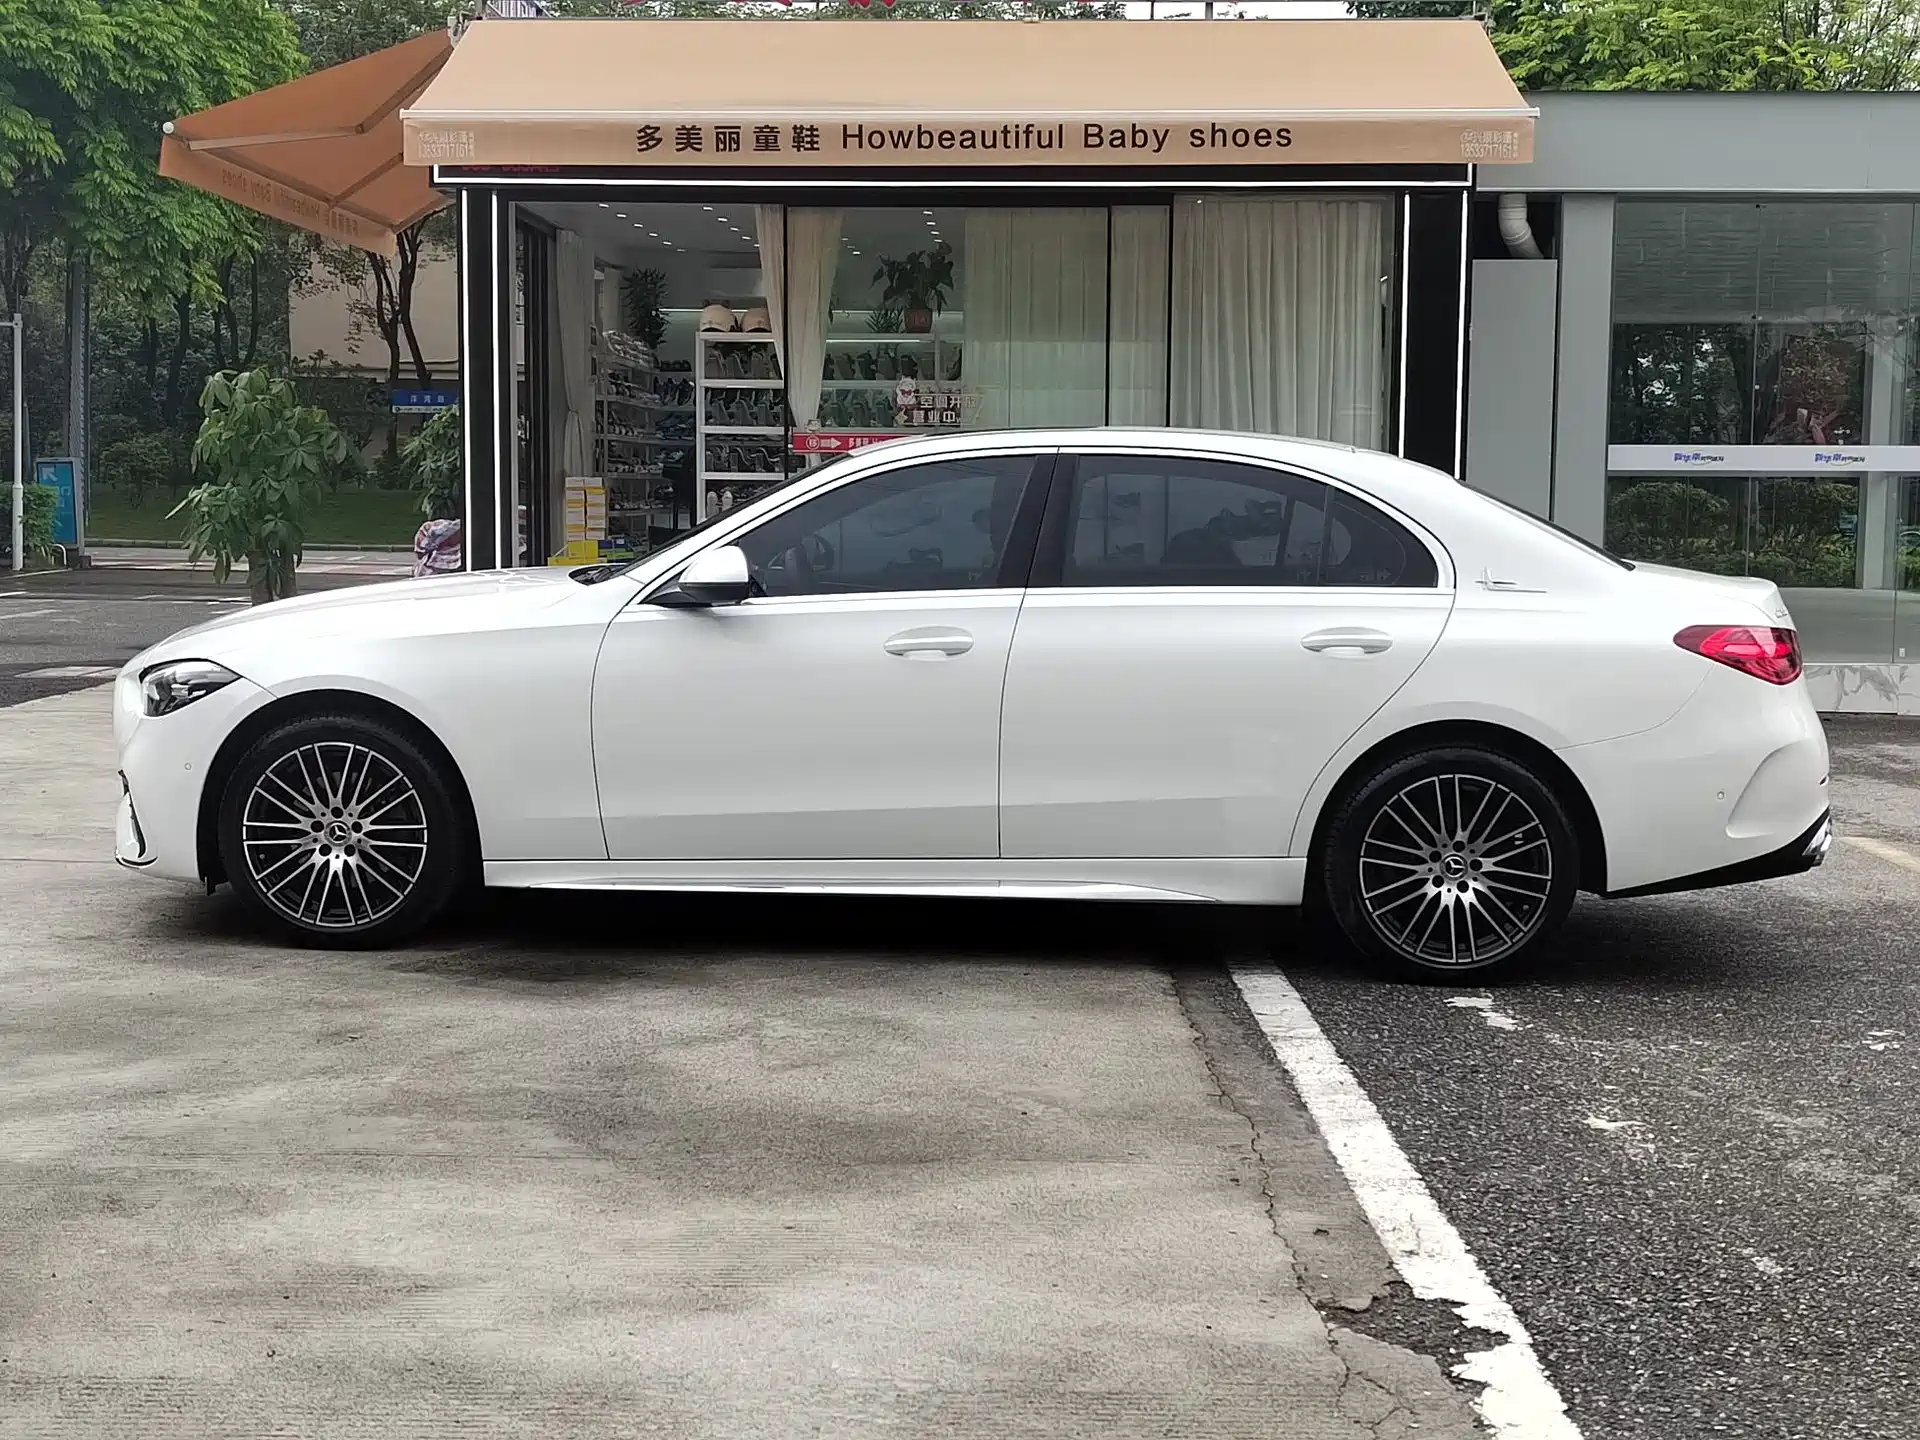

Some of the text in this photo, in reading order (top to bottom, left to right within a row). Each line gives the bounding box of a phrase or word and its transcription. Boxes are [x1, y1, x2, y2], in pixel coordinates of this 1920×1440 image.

[636, 124, 821, 153] 多美丽童鞋
[842, 122, 1293, 153] Howbeautiful Baby shoes
